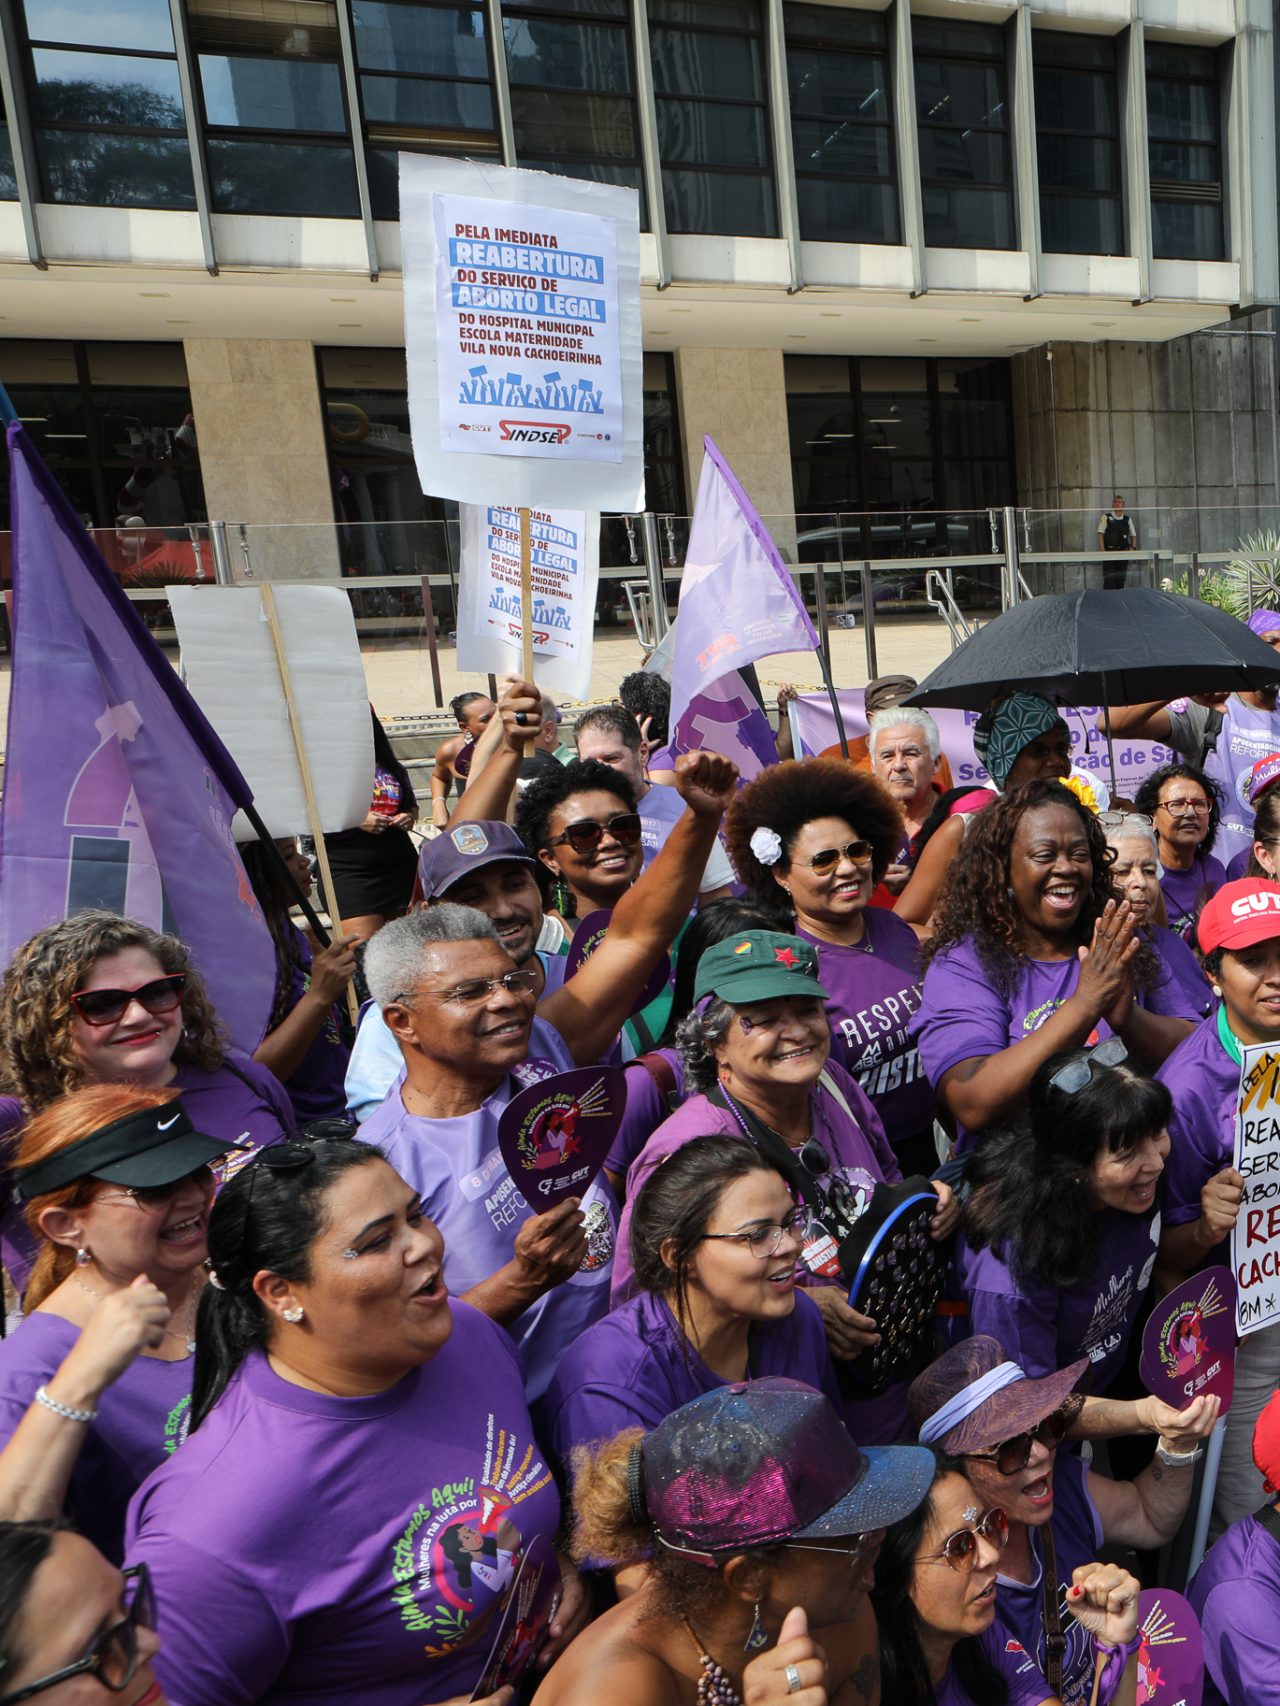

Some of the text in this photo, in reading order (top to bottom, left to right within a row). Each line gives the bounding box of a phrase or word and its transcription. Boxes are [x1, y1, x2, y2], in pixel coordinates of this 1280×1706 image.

[455, 223, 558, 249] PELA IMEDIATA
[456, 241, 599, 280] REABERTURA
[457, 269, 558, 293] DO SERVIÇO DE
[457, 285, 600, 320] ABORTO LEGAL
[458, 312, 595, 337] DO HOSPITAL MUNICIPAL
[459, 327, 583, 350] ESCOLA MATERNIDADE
[460, 341, 602, 366] VILA NOVA CACHOEIRINHA
[498, 419, 572, 445] SINDSEP
[491, 527, 549, 551] DO DE
[491, 562, 512, 575] ESCOLA
[532, 567, 570, 582] MUNICIPAL
[538, 551, 574, 573] LEGAL
[491, 571, 504, 582] VILA
[1120, 748, 1146, 766] de
[1242, 1053, 1275, 1094] PELA
[1239, 1299, 1261, 1327] 8M
[480, 1412, 494, 1486] Igualdade de direitos
[503, 1445, 515, 1473] jornada
[507, 1480, 528, 1499] Justiça
[416, 1497, 478, 1592] Mulheres na luta por
